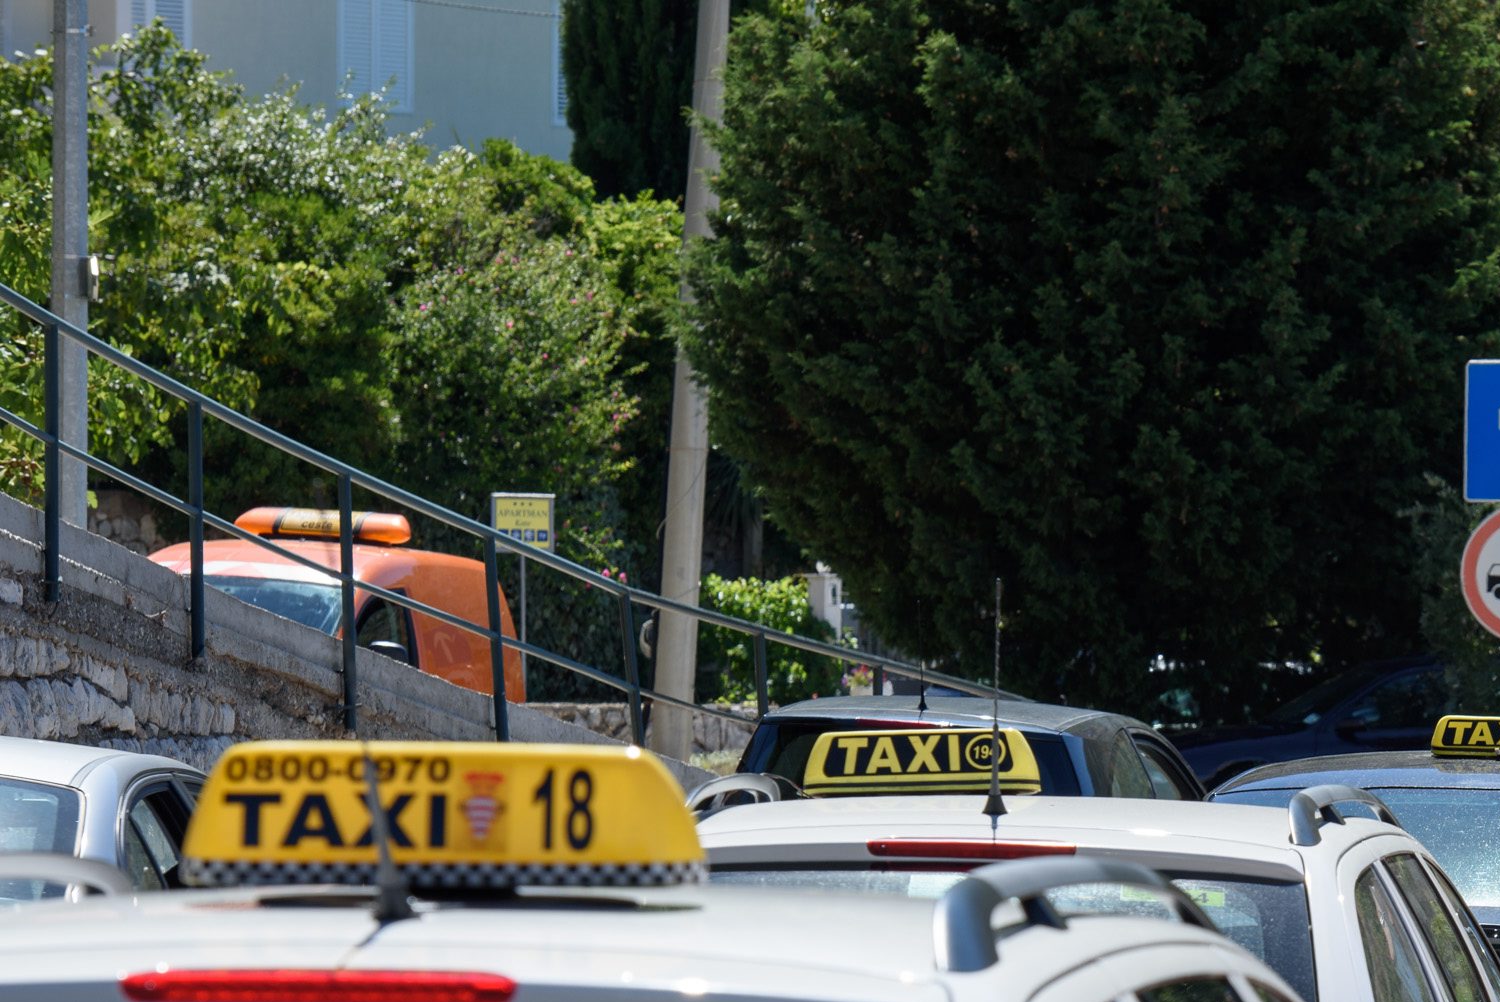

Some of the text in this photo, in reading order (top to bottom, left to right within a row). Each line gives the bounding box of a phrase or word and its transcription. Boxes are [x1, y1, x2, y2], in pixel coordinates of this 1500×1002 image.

[301, 519, 333, 530] ceste
[498, 509, 548, 518] APARTMAN
[837, 734, 961, 775] TAXI
[226, 756, 451, 783] 0800-0970
[225, 769, 594, 851] TAXI 18
